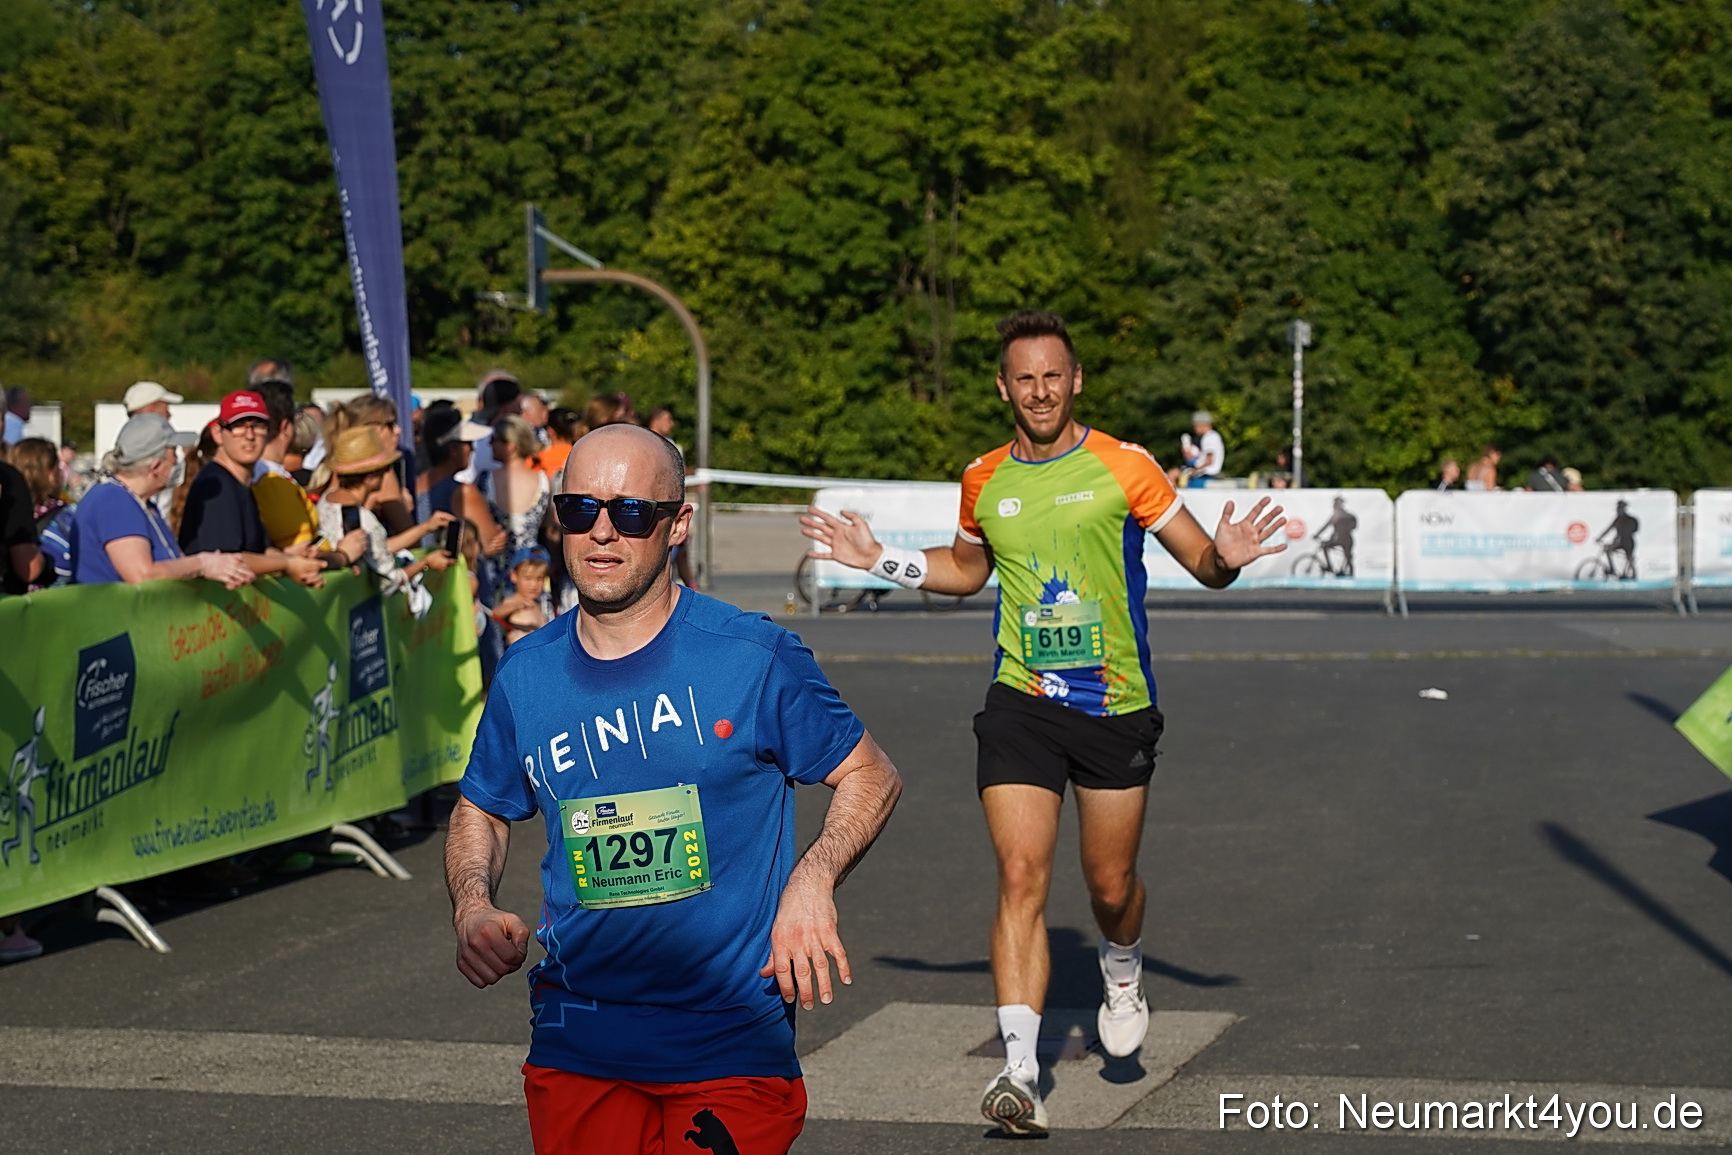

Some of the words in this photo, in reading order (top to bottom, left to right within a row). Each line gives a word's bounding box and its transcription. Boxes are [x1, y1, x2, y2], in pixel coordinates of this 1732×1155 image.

[1038, 626, 1082, 648] 619
[84, 670, 130, 701] Fischer
[46, 808, 104, 853] neumarkt
[591, 813, 634, 828] Firmenlauf
[608, 820, 634, 830] neumarkt
[585, 827, 678, 872] 1297
[683, 829, 703, 880] 2022
[572, 850, 588, 888] RUN
[591, 874, 651, 888] Neumann
[654, 867, 683, 882] Eric
[620, 888, 649, 897] Technologies
